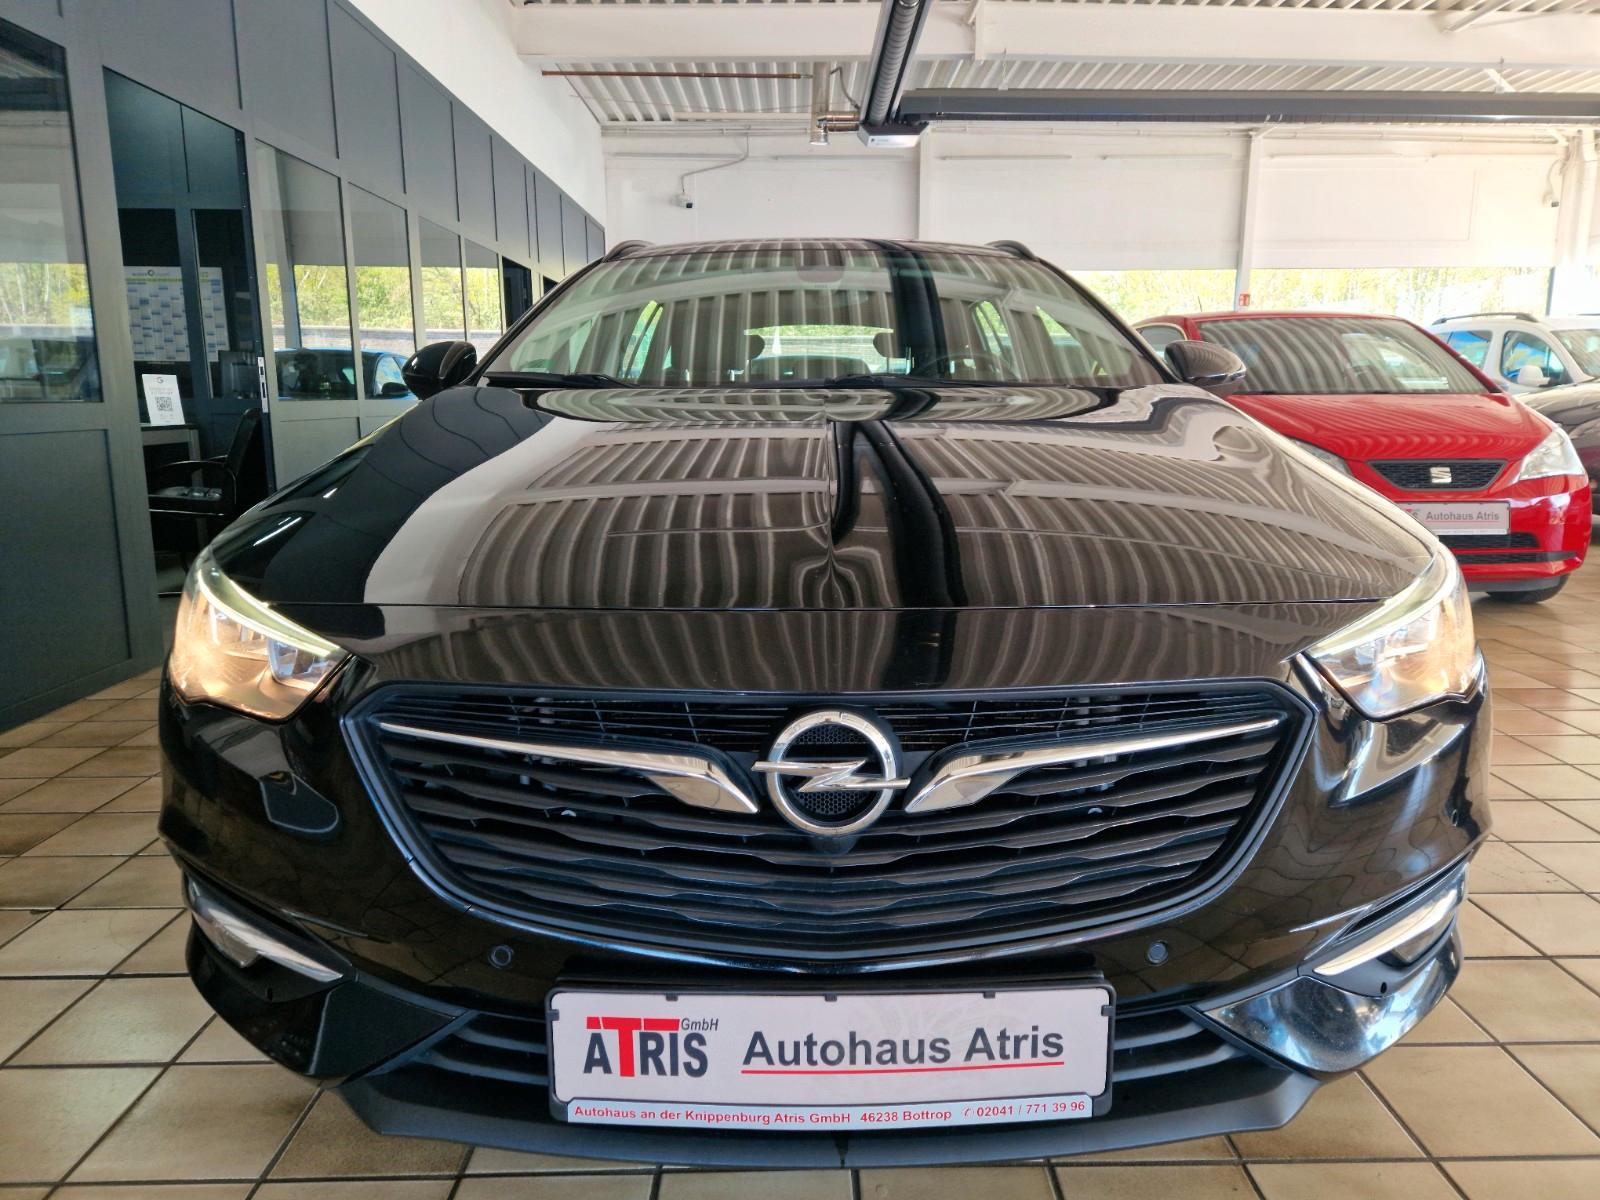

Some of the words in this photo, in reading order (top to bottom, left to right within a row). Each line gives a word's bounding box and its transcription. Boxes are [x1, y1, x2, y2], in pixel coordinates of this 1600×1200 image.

[1426, 511, 1473, 521] Autohaus
[1476, 511, 1500, 521] Atris
[681, 1018, 719, 1031] GmbH
[583, 1016, 708, 1078] ATRIS
[742, 1031, 951, 1067] Autohaus
[964, 1025, 1064, 1062] Atris
[574, 1106, 636, 1119] Autohaus
[640, 1109, 656, 1119] an
[660, 1109, 681, 1120] der
[685, 1111, 770, 1125] Knippenburg
[774, 1113, 805, 1123] Atris
[809, 1113, 850, 1123] GmbH
[860, 1112, 898, 1122] 46238
[903, 1109, 952, 1122] Bottrop
[976, 1105, 1014, 1117] 02041
[1026, 1103, 1047, 1114] 771
[1053, 1102, 1067, 1112] 39
[1070, 1101, 1085, 1111] 96
